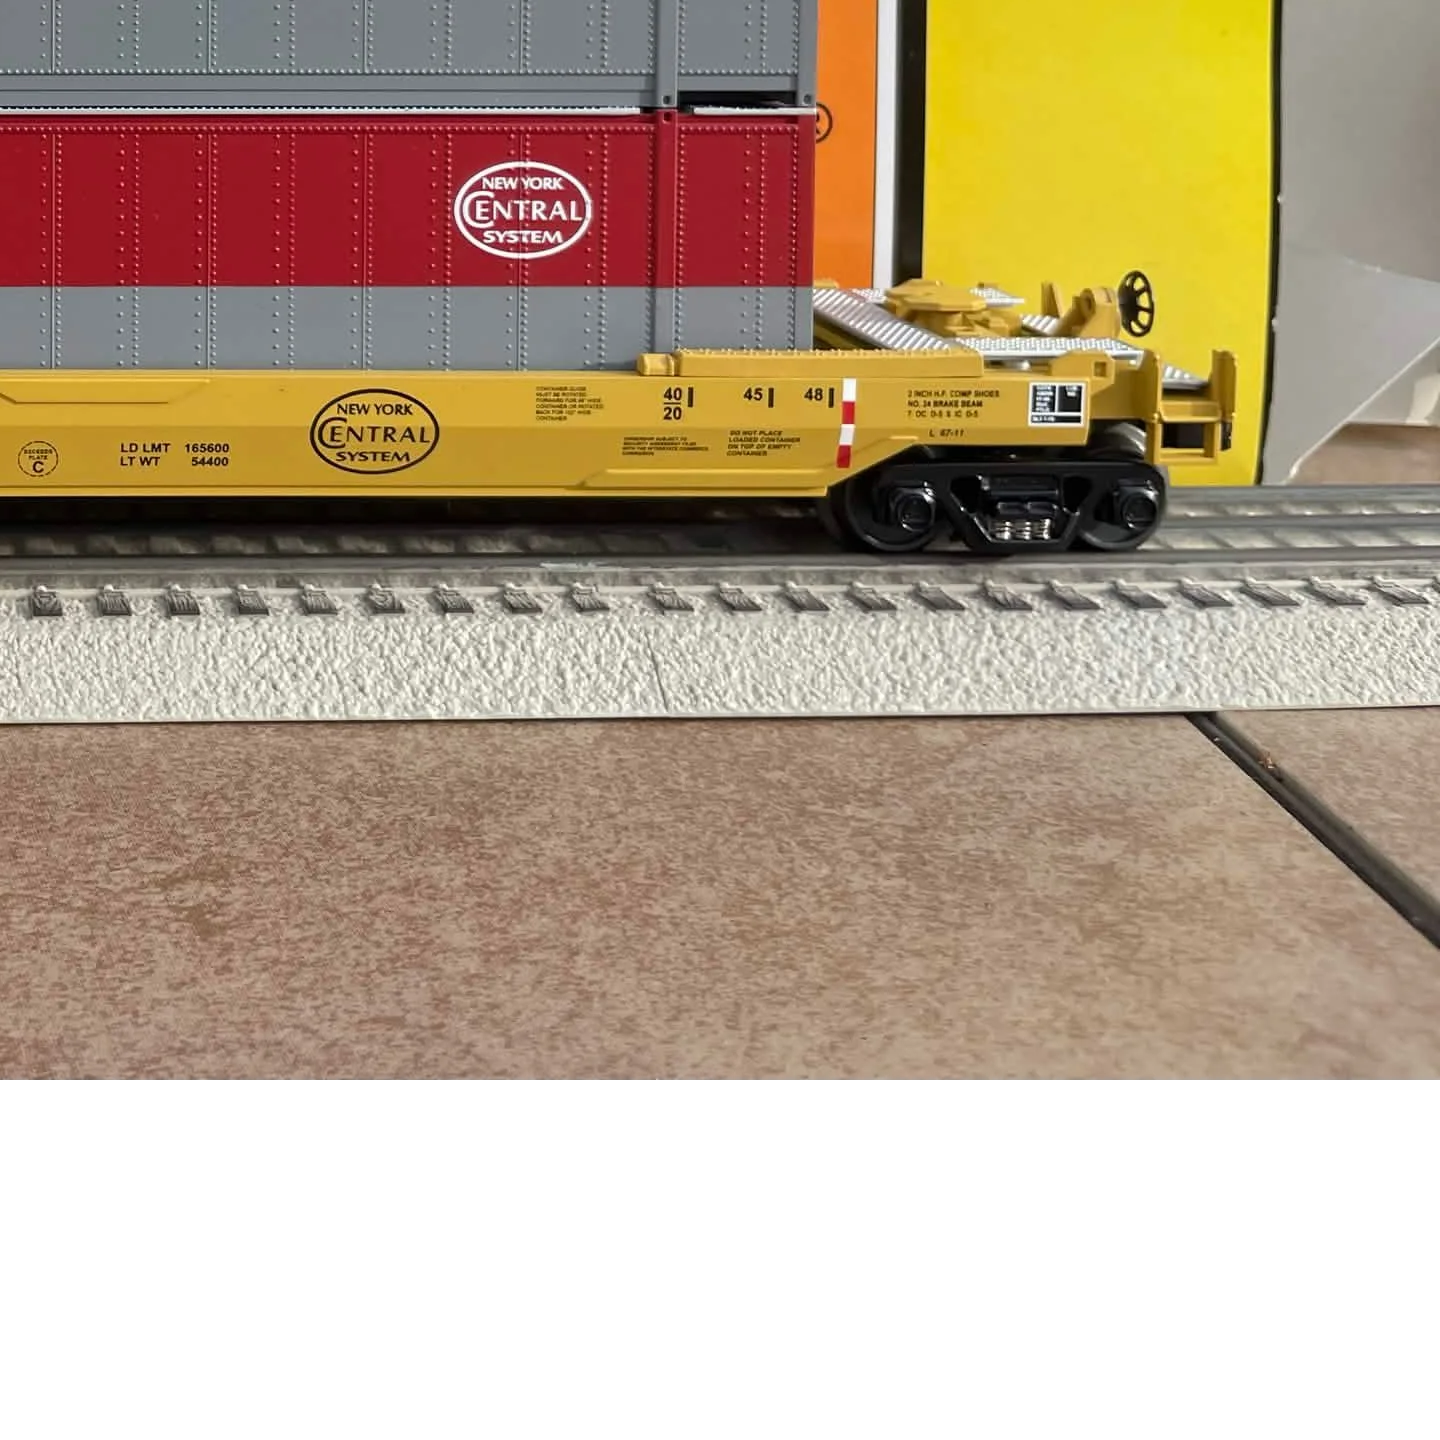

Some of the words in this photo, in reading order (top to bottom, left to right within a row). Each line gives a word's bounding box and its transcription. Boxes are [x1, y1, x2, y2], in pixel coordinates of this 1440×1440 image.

[482, 176, 518, 190] NEW
[520, 176, 564, 190] YORK
[462, 190, 583, 229] CENTRAL
[483, 230, 563, 244] SYSTEM
[664, 387, 682, 401] 40
[743, 388, 763, 401] 45
[804, 388, 823, 401] 48
[337, 403, 370, 415] NEW
[374, 403, 413, 415] YORK
[664, 407, 682, 420] 20
[318, 417, 431, 449] CENTRAL
[120, 443, 138, 453] LD
[142, 443, 171, 453] LMT
[185, 443, 229, 453] 165600
[120, 456, 135, 466] LT
[139, 456, 160, 466] WT
[192, 456, 229, 466] 54400
[335, 451, 410, 462] SYSTEM
[33, 461, 44, 473] C
